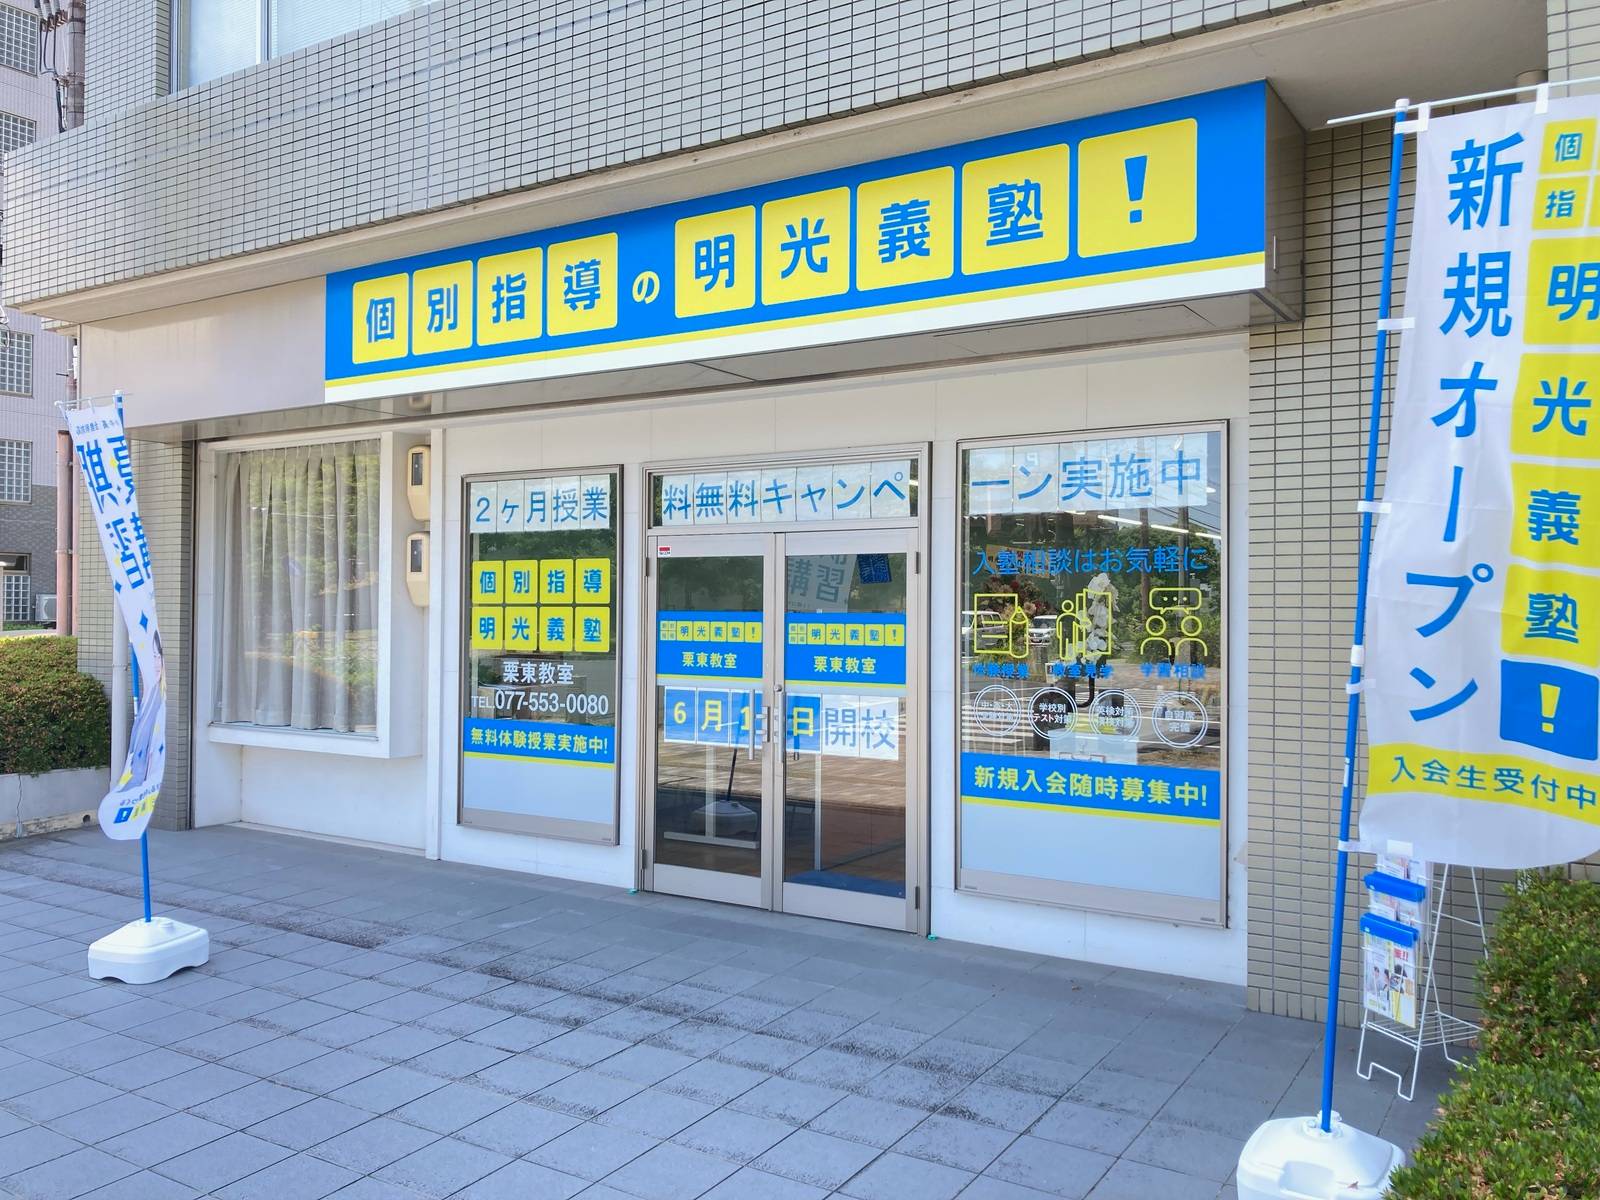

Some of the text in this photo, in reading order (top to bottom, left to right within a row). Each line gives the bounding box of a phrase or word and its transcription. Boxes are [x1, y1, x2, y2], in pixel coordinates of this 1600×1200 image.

[365, 154, 1149, 344] 個別指導の明光義塾!
[1406, 132, 1525, 722] 新規オープン
[971, 449, 1201, 501] ーン実施中
[662, 471, 906, 520] 料無料キャンペ
[972, 546, 1209, 576] 入塾相談はお気軽に
[479, 568, 604, 595] 個別指導
[479, 617, 603, 643] 明光義塾
[502, 660, 575, 685] 栗東教室
[682, 651, 737, 668] 栗東教室
[813, 655, 877, 675] 栗東教室
[1039, 703, 1067, 715] 学校別
[470, 727, 608, 754] 無料体験授業実施中!
[974, 765, 1208, 807] 新規入会随時募集中!
[1391, 755, 1598, 810] 入会生受付中
